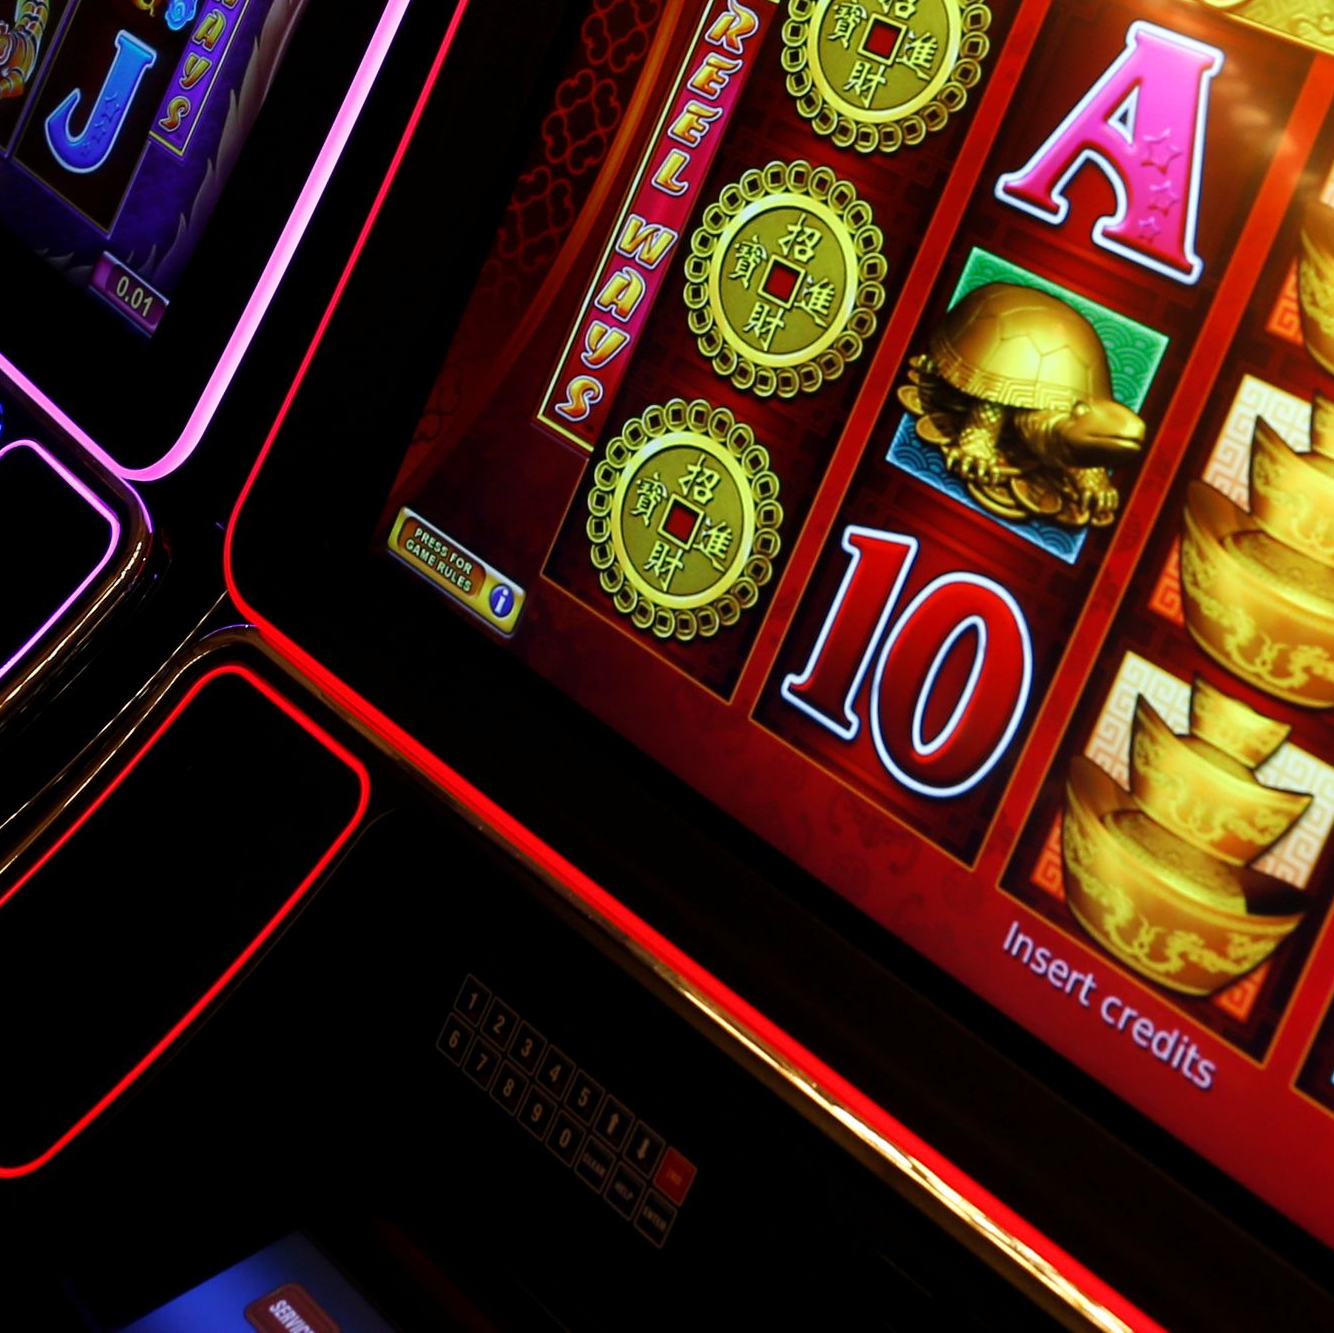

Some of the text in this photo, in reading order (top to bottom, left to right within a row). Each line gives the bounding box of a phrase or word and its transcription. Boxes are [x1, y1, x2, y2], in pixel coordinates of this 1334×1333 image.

[44, 28, 157, 174] J
[994, 21, 1225, 284] A
[116, 275, 154, 318] 0.01
[554, 212, 679, 425] WAYS
[406, 539, 473, 592] GAME RULES
[415, 528, 472, 574] PRESS FOR
[782, 526, 1033, 798] 10
[1001, 920, 1219, 1093] Insert credits
